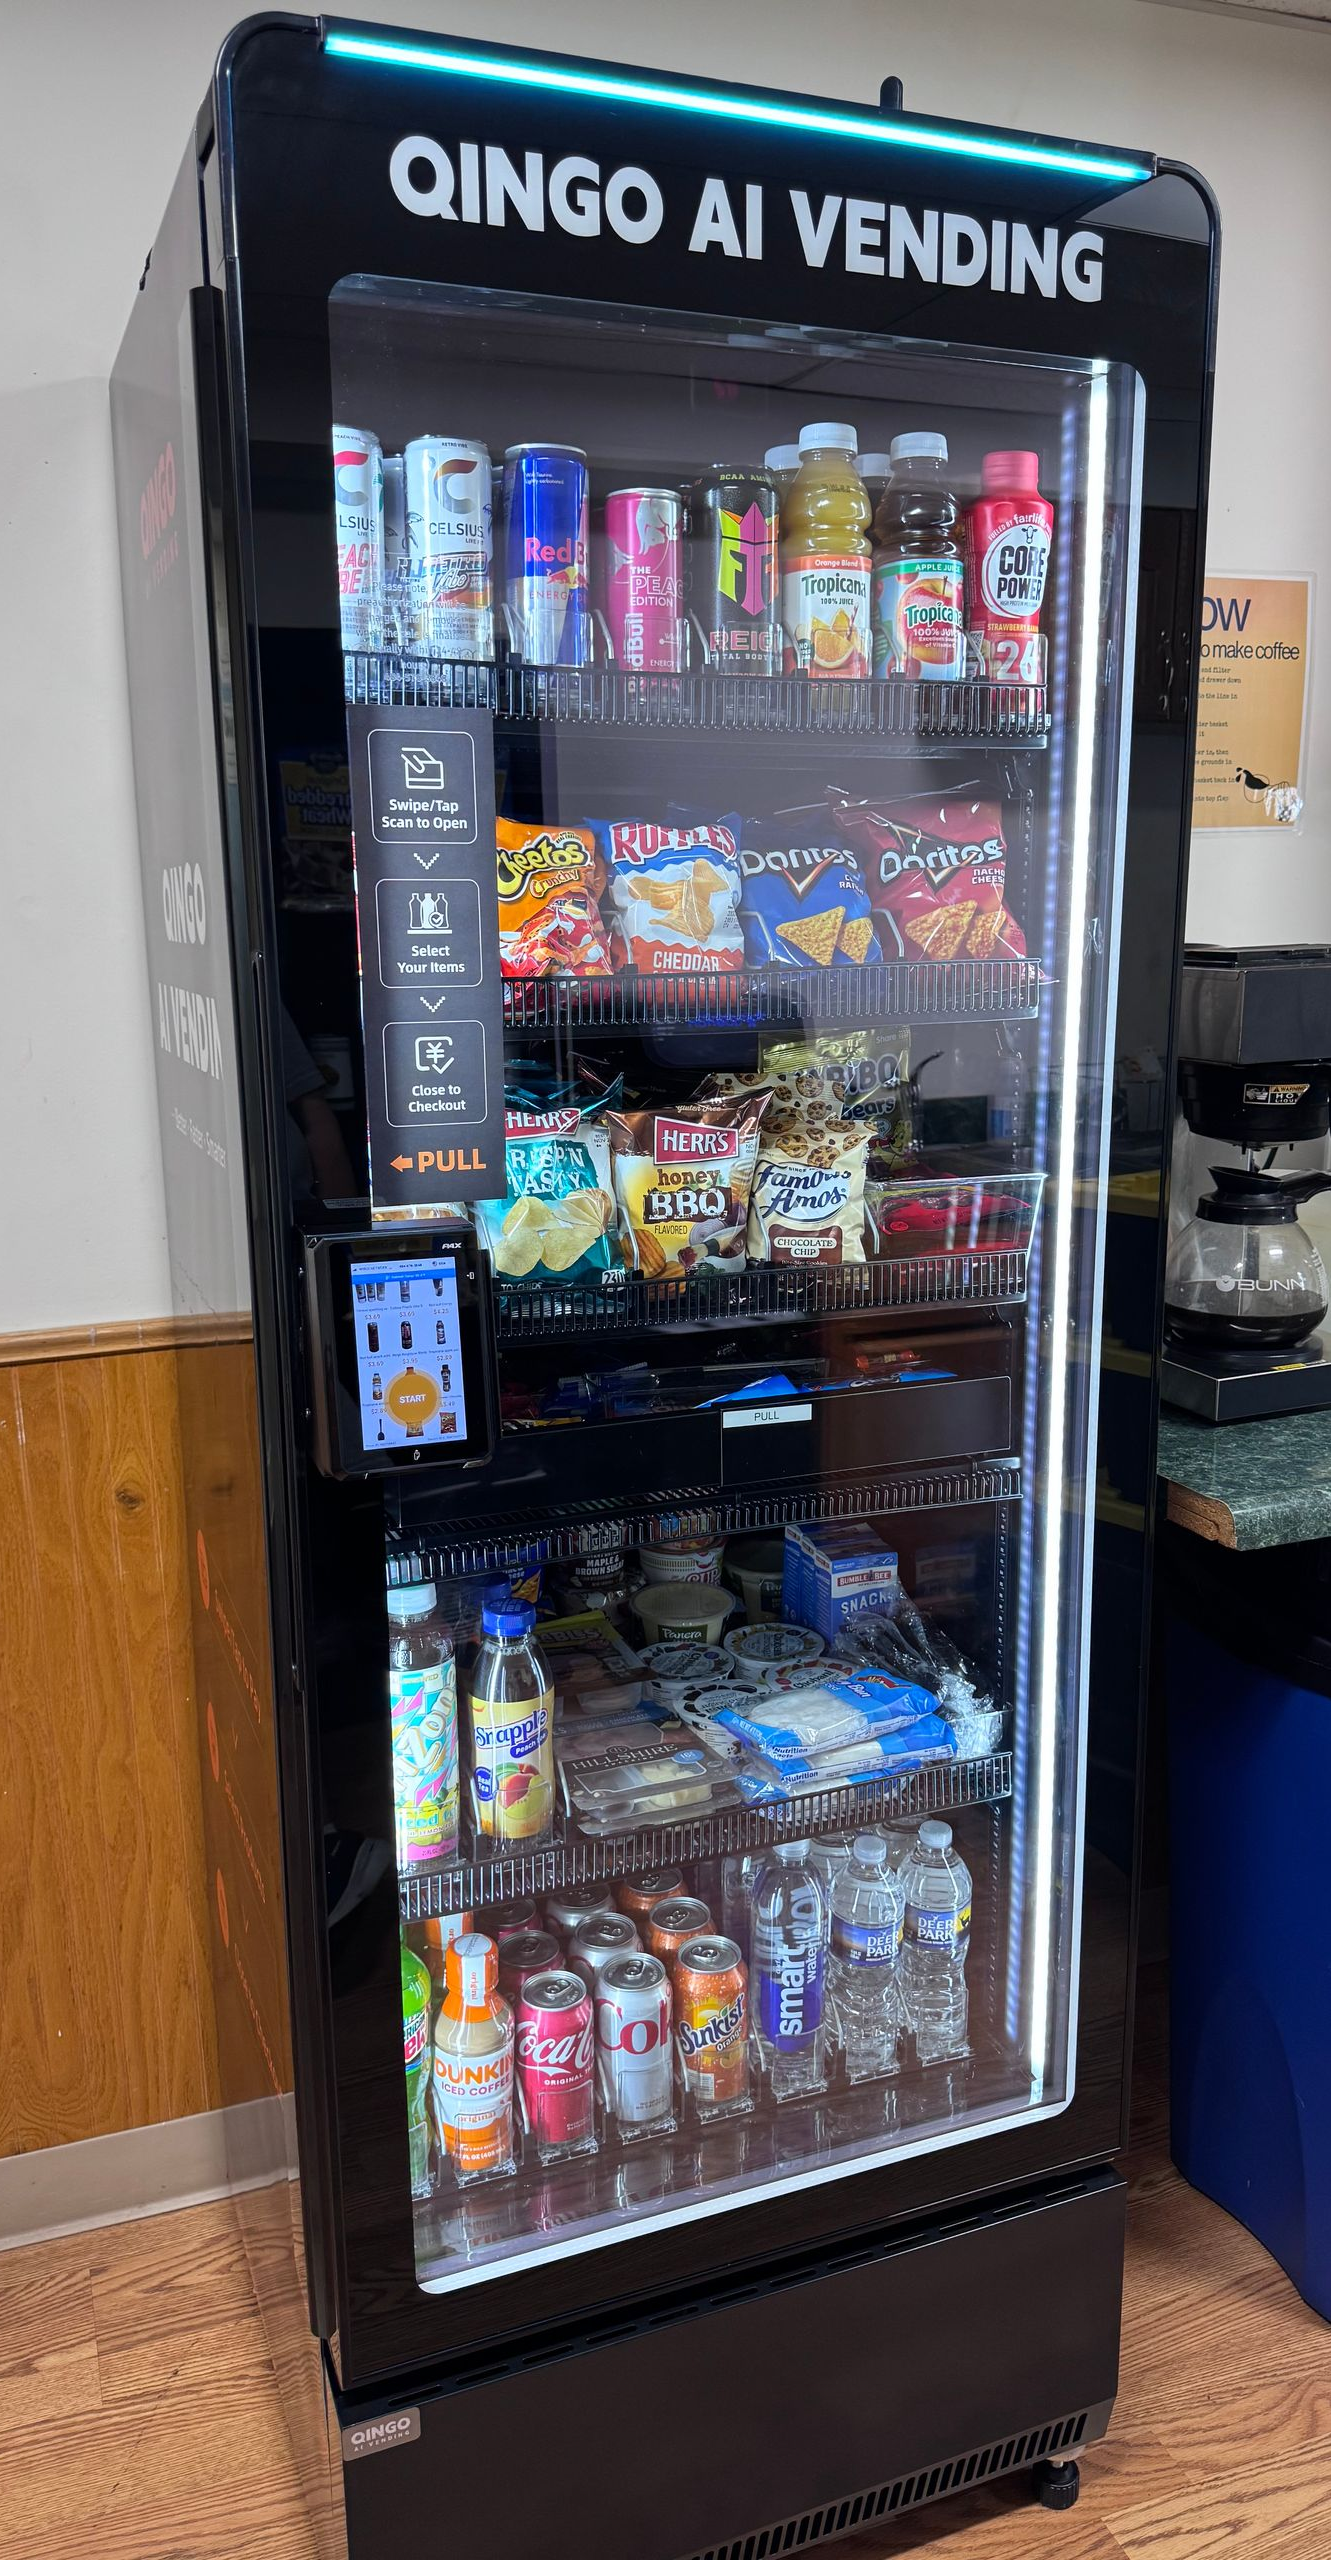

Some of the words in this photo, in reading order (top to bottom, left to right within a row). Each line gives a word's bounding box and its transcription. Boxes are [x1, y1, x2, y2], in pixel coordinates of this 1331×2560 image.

[389, 135, 665, 244] QINGO
[688, 177, 763, 260] AI
[788, 189, 1105, 303] VENDING
[720, 473, 745, 481] BCAA
[141, 441, 176, 560] QINGO
[339, 515, 375, 532] LSIUS
[429, 522, 484, 538] CELSIUS
[525, 537, 571, 563] Red
[814, 558, 840, 568] Orange
[915, 563, 941, 572] APPLE
[999, 545, 1046, 578] CORE
[630, 566, 651, 575] THE
[338, 569, 362, 594] BE
[629, 575, 684, 599] PEAC
[802, 573, 867, 597] Tropicana
[997, 577, 1041, 601] POWER
[630, 597, 673, 608] EDITION
[914, 628, 939, 636] 100%
[710, 630, 777, 652] REIG
[1213, 641, 1253, 659] make
[1255, 641, 1300, 660] coffee
[389, 798, 459, 814] Swipe/Tap
[381, 816, 413, 829] Scan
[416, 818, 430, 829] to
[433, 817, 468, 831] Open
[611, 821, 739, 864] RUFFLES
[497, 839, 586, 896] Cheetos
[740, 847, 858, 877] Doritos
[880, 838, 1004, 884] Doritos
[973, 868, 1006, 877] NACHO
[530, 869, 579, 897] Crunchy
[162, 862, 206, 945] QINGO
[411, 945, 450, 957] Select
[397, 961, 428, 974] Your
[430, 961, 465, 973] Items
[653, 951, 719, 971] CHEDDAR
[412, 1085, 445, 1097] Close
[448, 1085, 461, 1096] to
[408, 1099, 466, 1112] Checkout
[661, 1130, 729, 1155] HERR'S
[418, 1148, 487, 1173] PULL
[657, 1168, 721, 1188] honey
[649, 1187, 726, 1220] BBQ
[762, 1187, 847, 1219] Amos
[654, 1224, 688, 1235] FLAVORED
[777, 1238, 833, 1247] CHOCOLATE
[794, 1248, 816, 1256] CHIP
[1238, 1279, 1305, 1292] BUNN
[399, 1394, 427, 1404] START
[754, 1411, 779, 1423] PULL
[587, 1557, 613, 1568] MAPLE
[576, 1566, 606, 1576] BROWN
[840, 1575, 868, 1585] BUMBLE
[874, 1572, 889, 1580] BEE
[662, 1628, 702, 1639] Panera
[475, 1709, 547, 1747] Snapple
[515, 1741, 536, 1755] Peach
[774, 1746, 808, 1754] Nutrition
[572, 1744, 680, 1770] HILLSHIRE
[784, 1770, 818, 1783] Nutrition
[918, 1915, 954, 1930] DEER
[867, 1933, 899, 1947] DEER
[917, 1929, 954, 1942] PARK
[779, 1944, 805, 2036] smart
[680, 1992, 745, 2055] Sunkist
[441, 2081, 466, 2096] ICED
[469, 2073, 511, 2096] COFFEE
[544, 2073, 583, 2086] ORIGINAL
[351, 2417, 411, 2445] QINGO
[369, 2430, 410, 2447] VENDING
